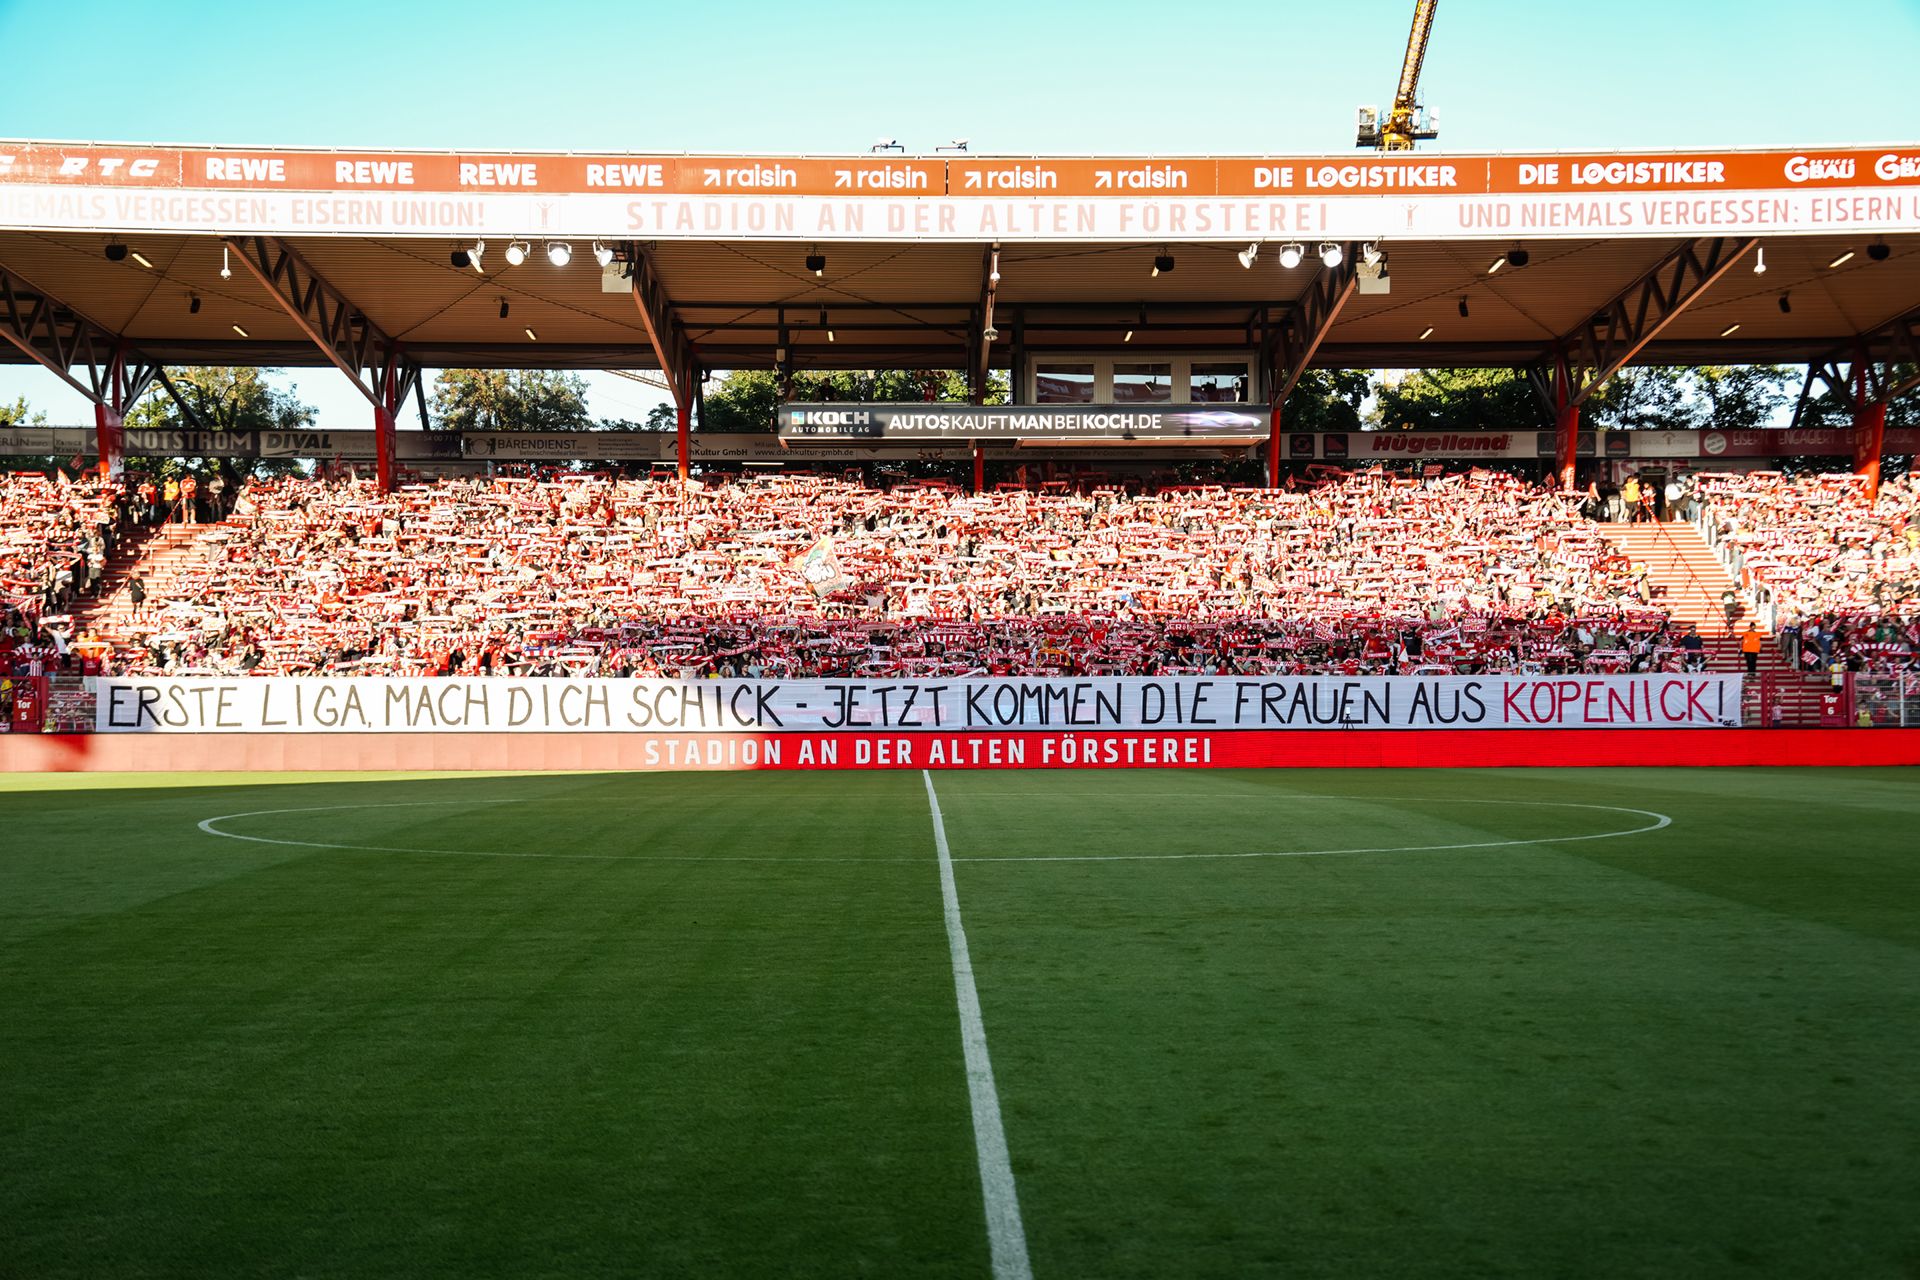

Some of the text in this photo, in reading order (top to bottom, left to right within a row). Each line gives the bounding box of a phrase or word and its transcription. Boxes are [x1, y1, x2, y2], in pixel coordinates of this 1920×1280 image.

[206, 157, 286, 182] REWE
[335, 160, 415, 185] REWE
[459, 163, 538, 187] REWE
[586, 163, 664, 187] REWE
[726, 164, 797, 188] raisin
[857, 165, 928, 189] raisin
[987, 164, 1057, 188] raisin
[1117, 164, 1188, 188] raisin
[1254, 164, 1457, 188] DIE LOGISTIKER
[1518, 160, 1725, 186] DIE LOGISTIKER
[115, 195, 277, 224] VERGESSEN:
[291, 198, 383, 225] EISERN
[392, 200, 484, 227] UNION!
[627, 201, 1328, 233] STADION AN DER ALTEN FÖRSTEREI
[1459, 203, 1511, 228] UND
[1521, 200, 1633, 227] NIEMALS
[1642, 198, 1799, 226] VERGESSEN:
[1811, 196, 1902, 223] EISERN
[806, 411, 870, 426] KOCH
[266, 433, 333, 449] DIVAL
[498, 438, 577, 450] BÄRENDIENST
[722, 449, 748, 457] GmbH
[755, 448, 855, 458] www.dachkultur-gmbh.de
[1372, 434, 1509, 454] Hügelland
[17, 699, 31, 709] Tor
[108, 684, 243, 728] ERSTE
[261, 684, 372, 729] LIGA,
[385, 683, 490, 728] MACH
[507, 683, 611, 727] DICH
[627, 683, 784, 728] SCHICK
[822, 684, 949, 728] JETZT
[966, 682, 1122, 726] KOMMEN
[1141, 682, 1217, 725] DIE
[1235, 681, 1391, 725] FRAUEN
[1407, 682, 1486, 724] AUS
[1503, 679, 1725, 724] KÖPENICK!
[1823, 694, 1838, 704] Tor
[1827, 707, 1834, 715] 6
[21, 711, 27, 720] 5
[644, 733, 1212, 766] STADION AN DER ALTEN FÖRSTEREI
